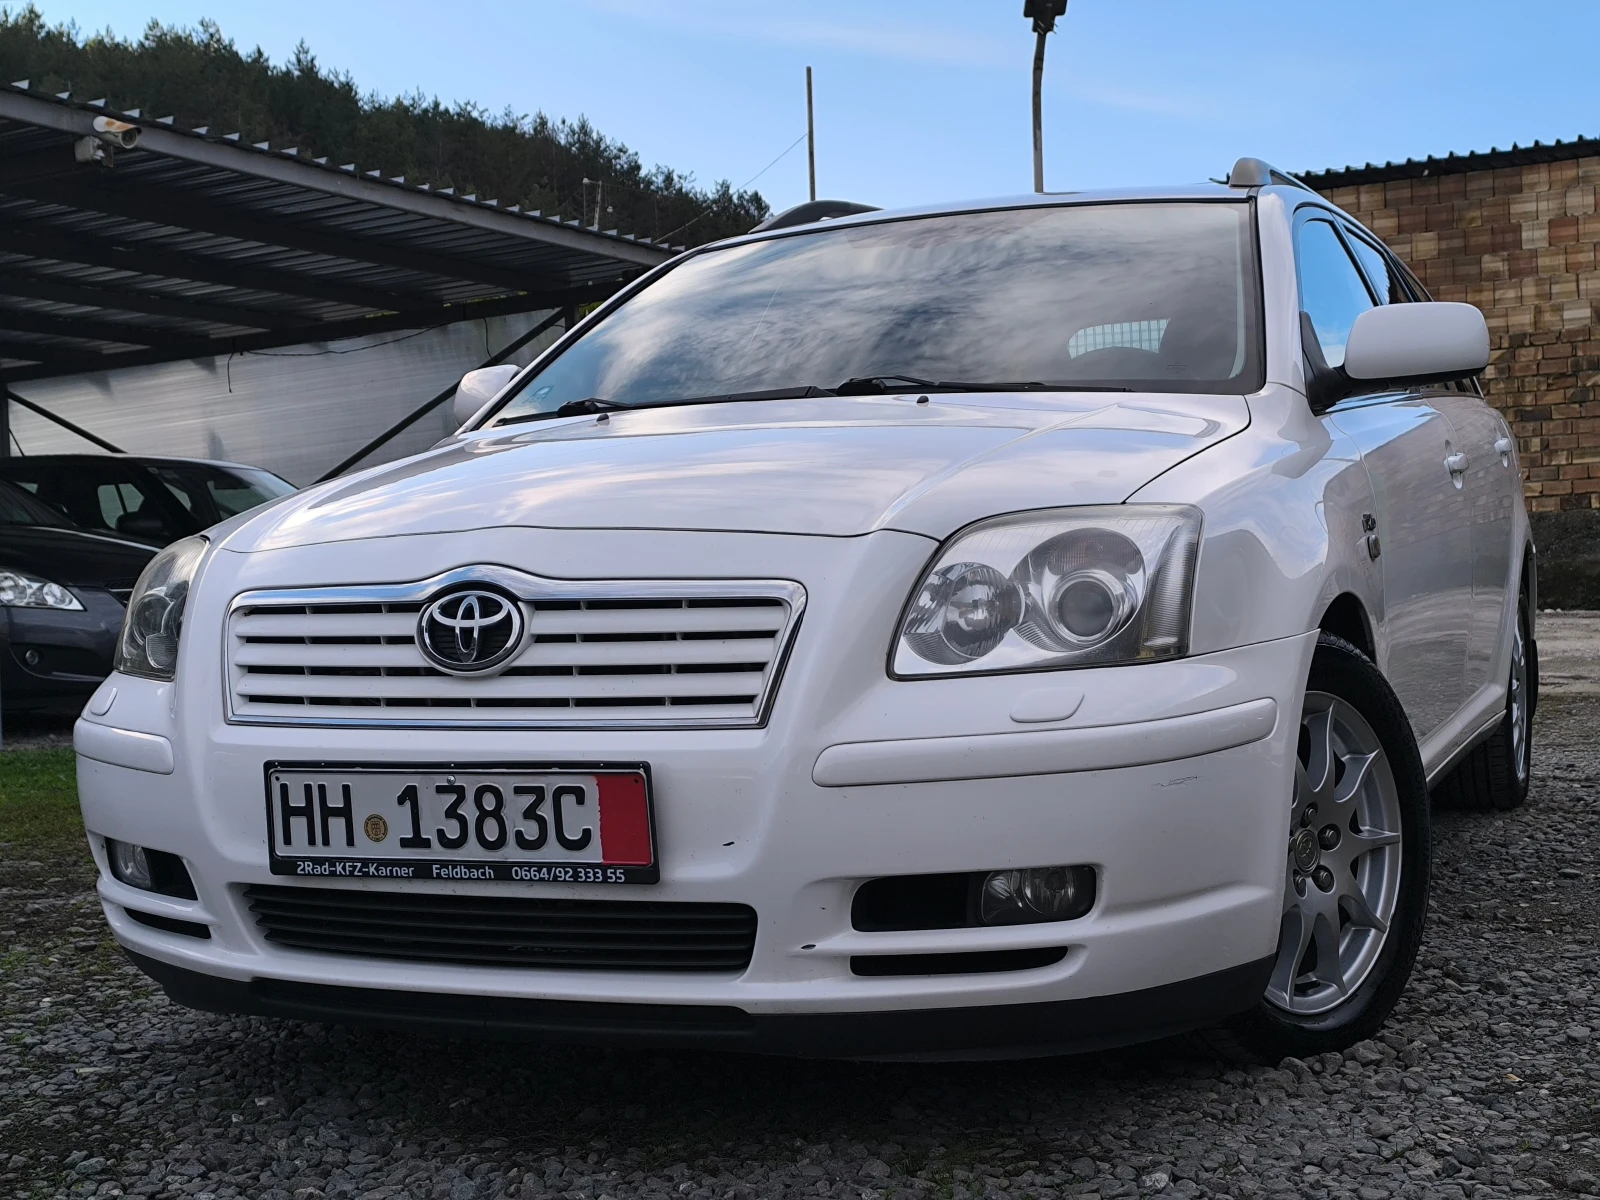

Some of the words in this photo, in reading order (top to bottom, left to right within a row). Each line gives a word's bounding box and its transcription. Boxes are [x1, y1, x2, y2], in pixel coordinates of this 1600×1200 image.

[279, 782, 355, 847] HH
[396, 784, 592, 851] 1383C
[296, 861, 415, 877] 2Rad-KFZ-Karner
[432, 864, 495, 879] Feldbach
[511, 866, 574, 881] 0664/92
[577, 868, 603, 882] 333
[607, 869, 626, 883] 55
